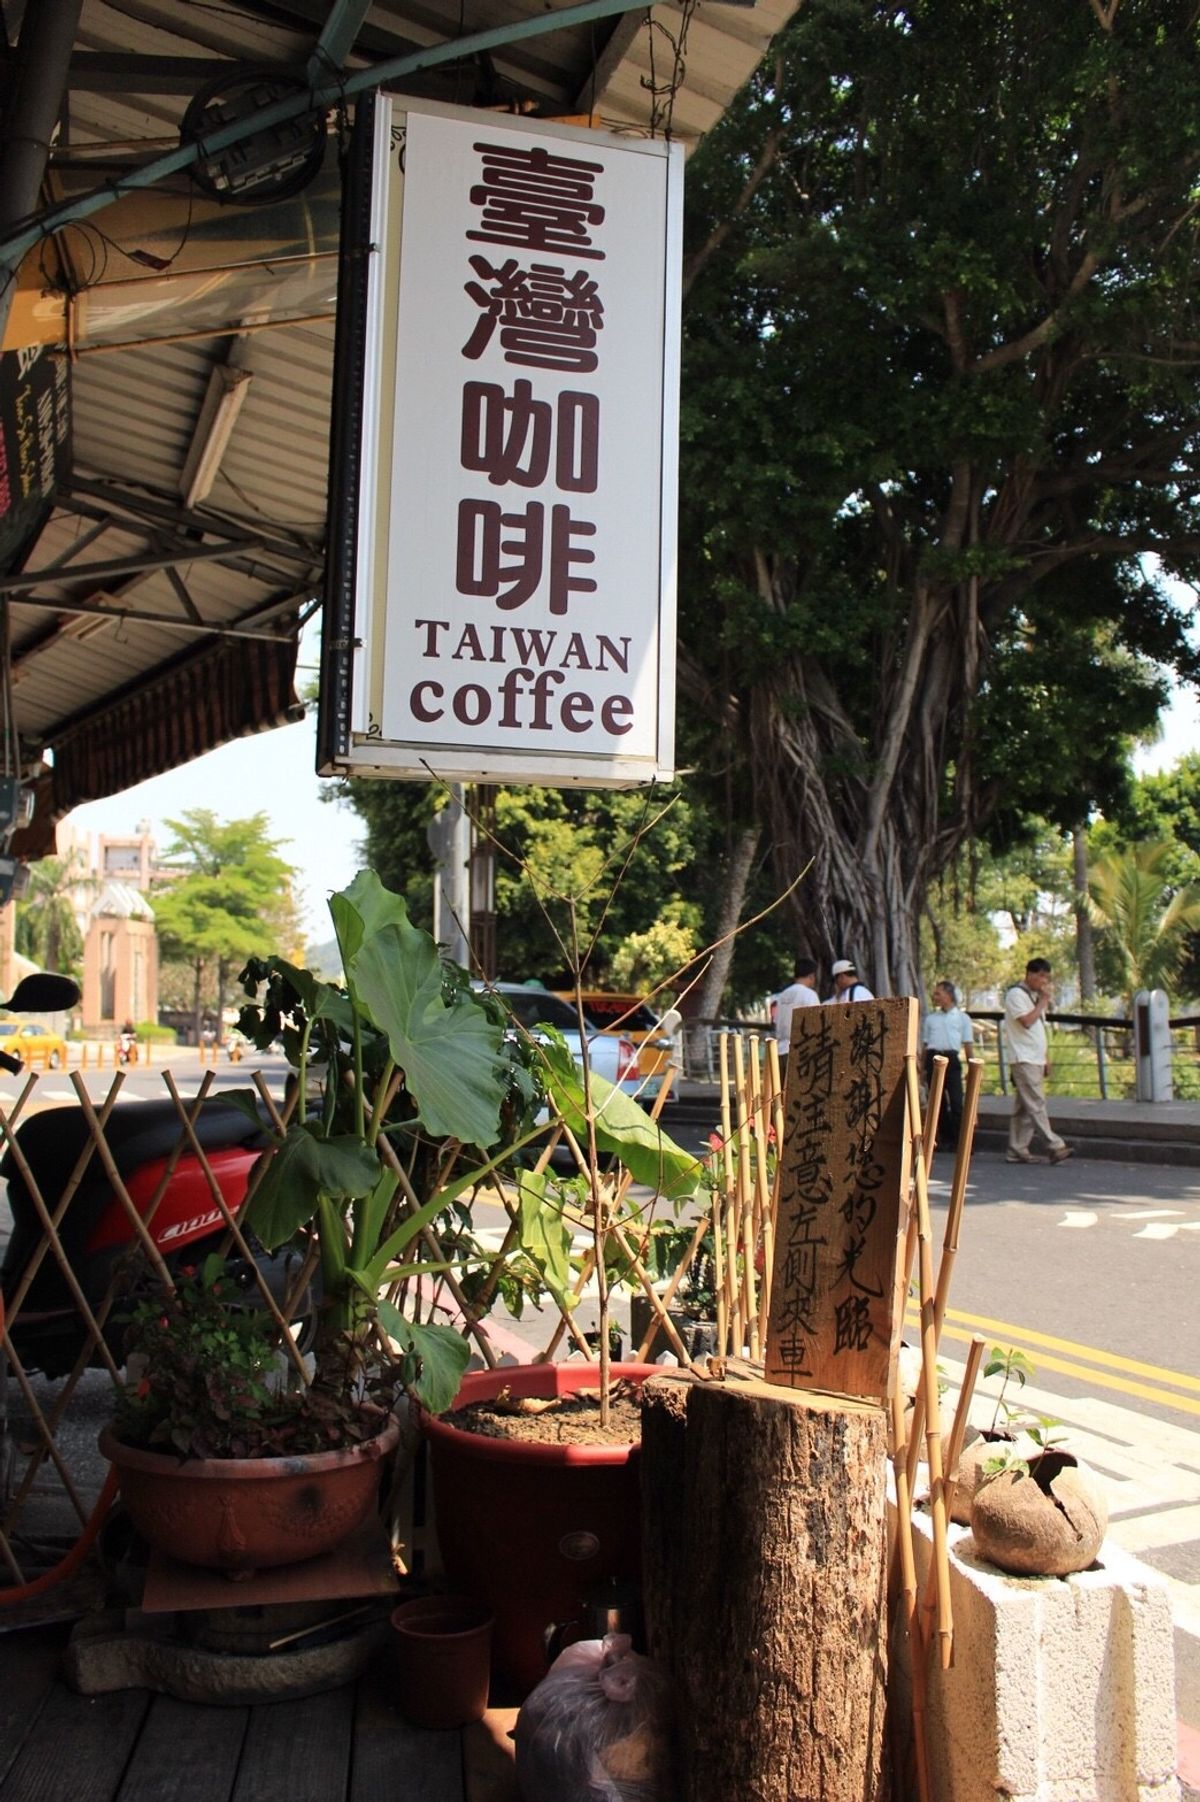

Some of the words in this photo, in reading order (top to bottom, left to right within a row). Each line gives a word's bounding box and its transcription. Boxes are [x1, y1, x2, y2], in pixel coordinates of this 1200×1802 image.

[455, 142, 606, 615] 臺灣咖啡
[410, 668, 634, 736] coffee
[415, 619, 632, 673] TAIWAN
[772, 1012, 841, 1386] 請注意左側來車
[831, 1009, 889, 1355] 謝謝您的光臨
